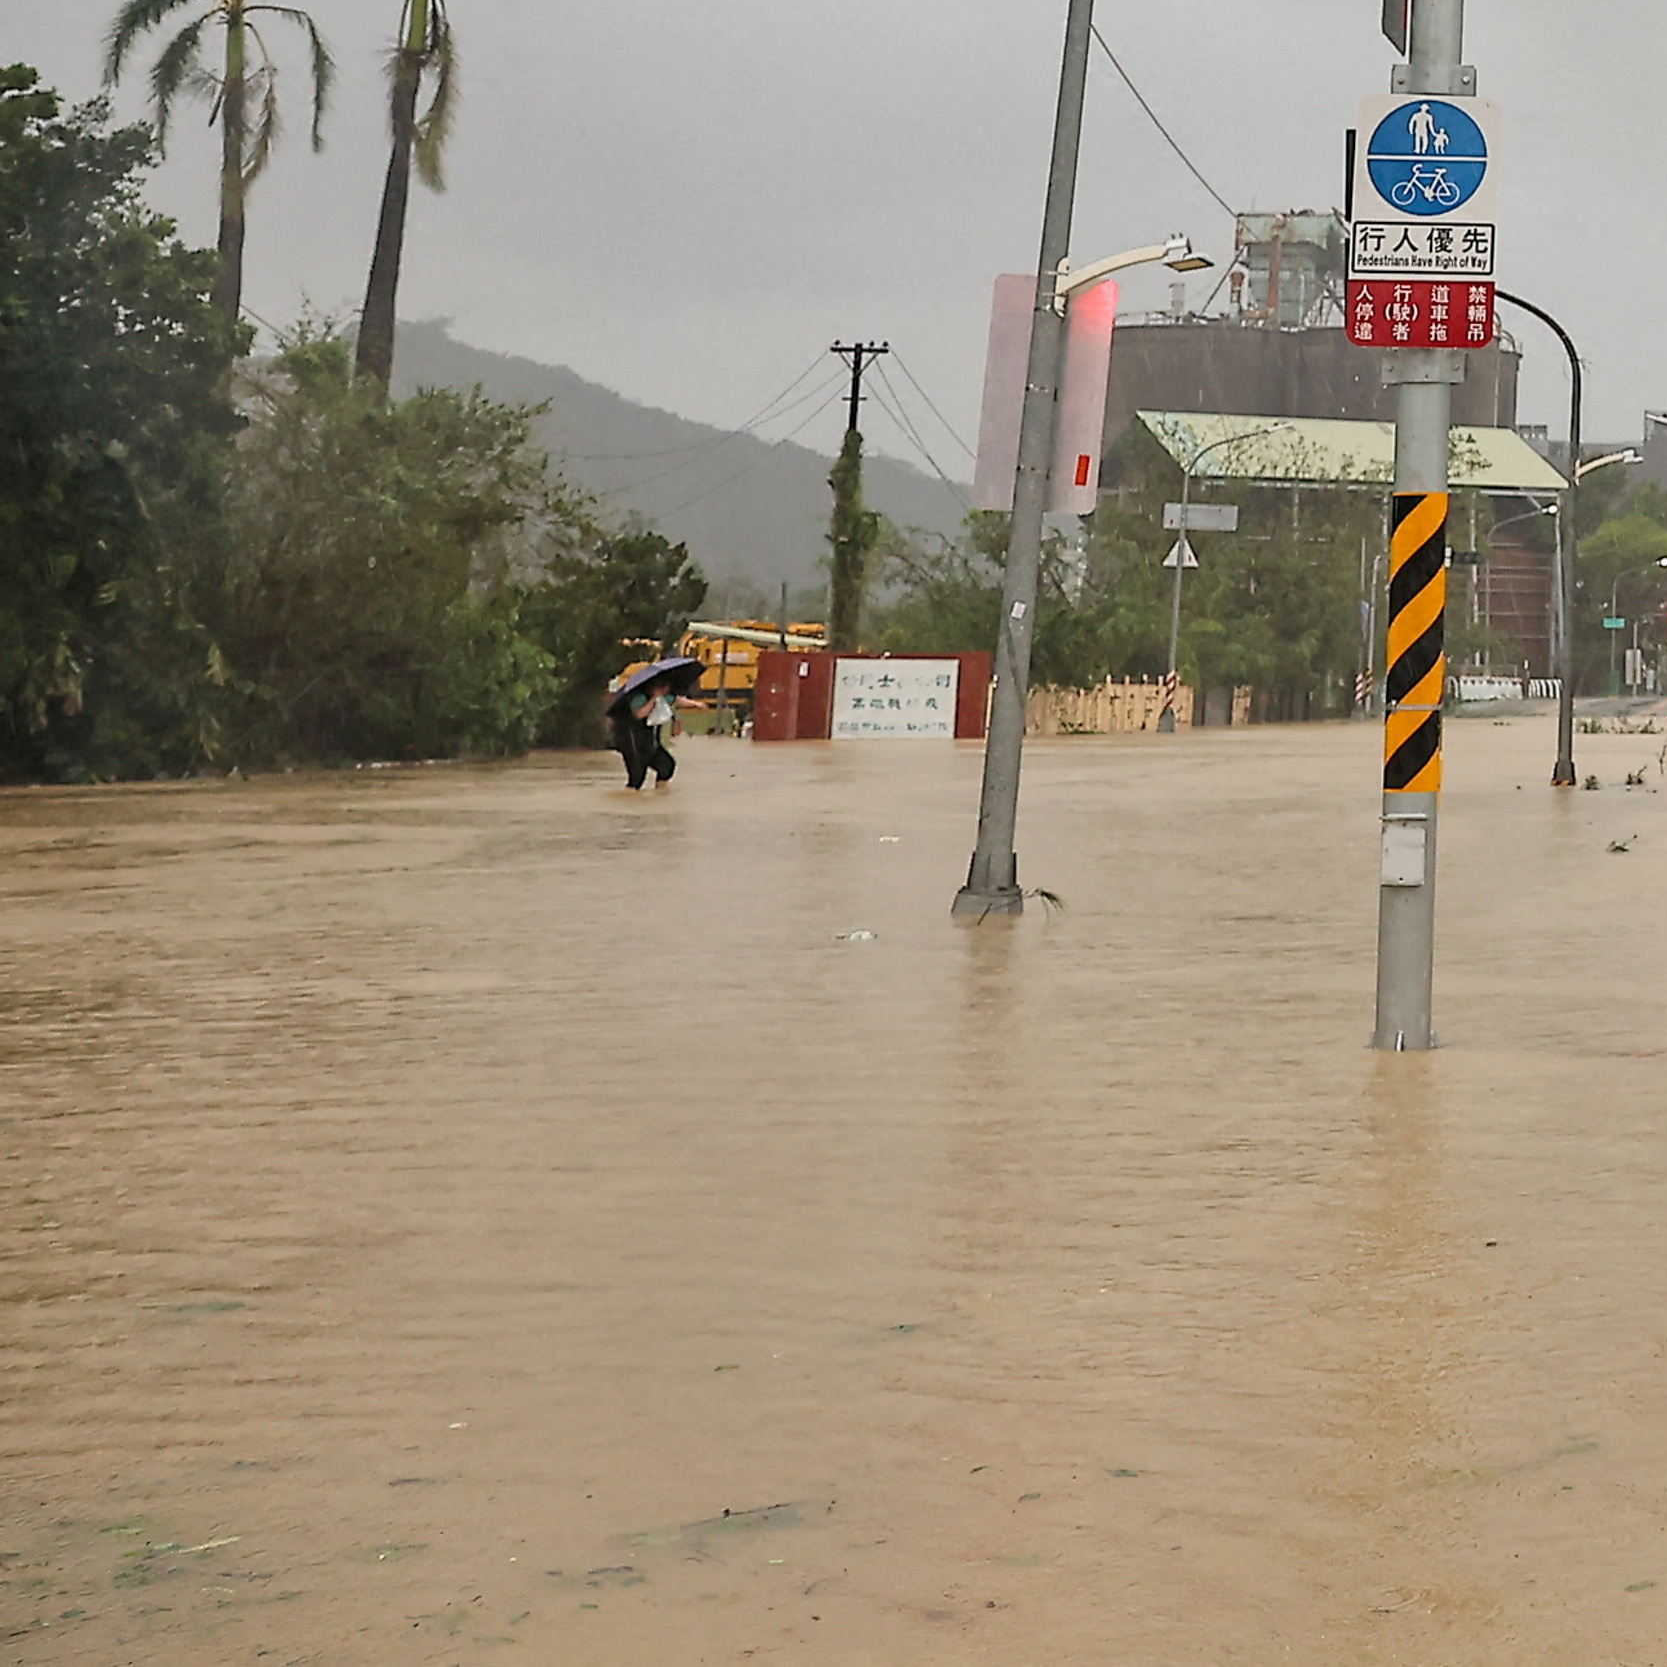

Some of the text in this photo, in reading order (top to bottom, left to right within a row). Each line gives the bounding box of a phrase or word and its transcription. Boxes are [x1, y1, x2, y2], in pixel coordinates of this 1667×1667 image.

[1359, 226, 1489, 254] 行人優先
[1357, 254, 1488, 271] Pedestrians Have Right of Way
[1355, 284, 1488, 304] 人行道禁
[1354, 322, 1485, 342] 違者拖吊
